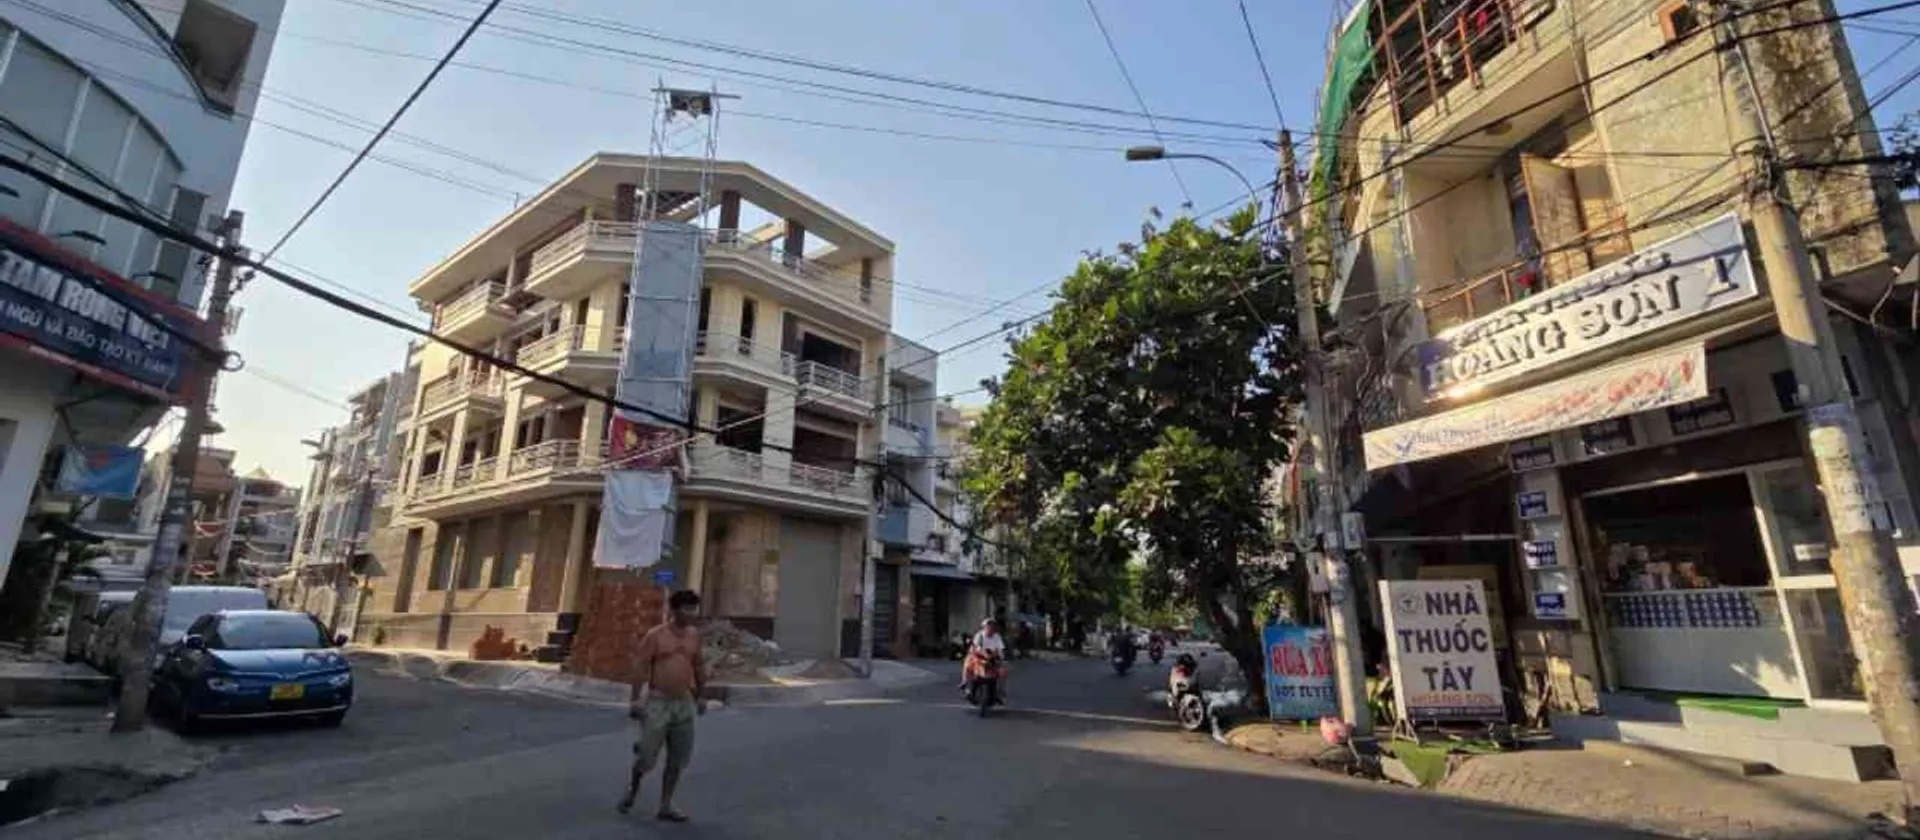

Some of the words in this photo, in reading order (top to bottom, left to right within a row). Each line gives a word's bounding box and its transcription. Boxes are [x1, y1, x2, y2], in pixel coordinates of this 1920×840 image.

[1424, 584, 1481, 615] NHÀ
[1397, 618, 1489, 653] THUỐC
[1421, 661, 1474, 691] TÂY
